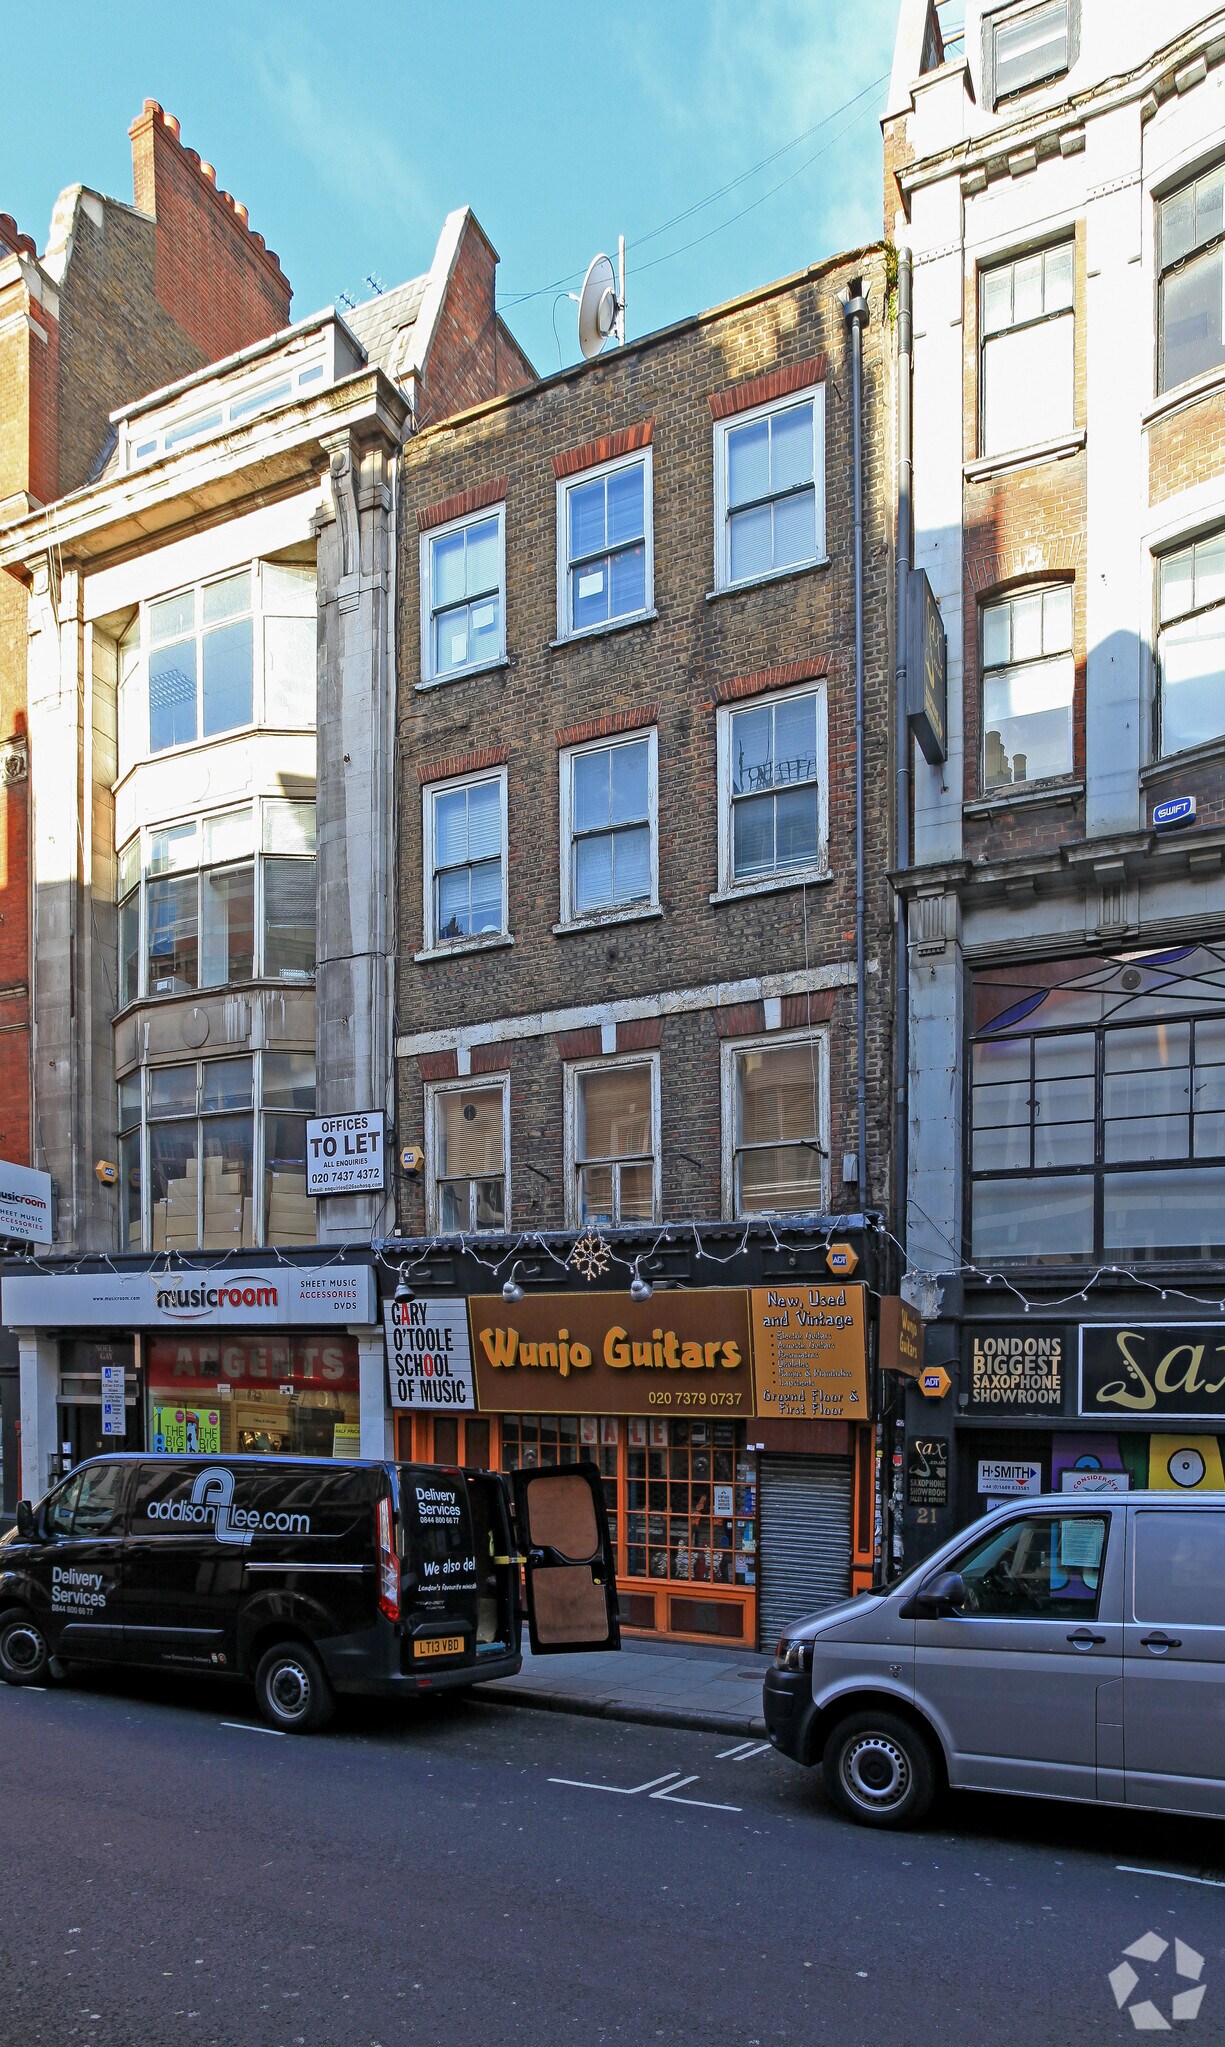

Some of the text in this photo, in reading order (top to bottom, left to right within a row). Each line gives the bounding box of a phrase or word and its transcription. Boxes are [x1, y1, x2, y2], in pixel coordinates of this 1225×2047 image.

[1158, 802, 1188, 818] SWIFT
[321, 1117, 368, 1133] OFFICES
[310, 1131, 380, 1158] TO LET
[336, 1158, 368, 1167] ENQUIRIES
[312, 1168, 379, 1184] 020 7437 4372
[0, 1190, 46, 1208] usicroom
[0, 1216, 43, 1231] CCESSORIES
[21, 1213, 42, 1223] MUSIC
[10, 1226, 29, 1234] DVDS
[832, 1256, 847, 1264] ADT
[300, 1279, 357, 1288] SHEET MUSIC
[156, 1281, 278, 1308] musicroom
[300, 1290, 357, 1298] ACCESSORIES
[767, 1289, 846, 1309] New, Used
[334, 1302, 357, 1310] DVDS
[391, 1303, 427, 1326] GARY
[763, 1310, 854, 1330] and Vintage
[393, 1328, 453, 1352] O'TOOLE
[973, 1338, 1061, 1356] LONDONS
[479, 1326, 742, 1377] Wunjo Guitars
[395, 1353, 453, 1377] SCHOOL
[973, 1356, 1061, 1375] BIGGEST
[925, 1378, 939, 1387] ADT
[973, 1375, 1061, 1390] SAXOPHONE
[398, 1379, 466, 1403] OF MUSIC
[649, 1391, 742, 1405] 020 7379 0737
[763, 1389, 859, 1402] Ground Floor &
[973, 1389, 1061, 1404] SHOWROOM
[779, 1403, 844, 1415] First Floor
[165, 1425, 183, 1436] THE
[198, 1427, 217, 1438] THE
[583, 1419, 664, 1443] SALE
[165, 1436, 183, 1447] BIG
[199, 1438, 217, 1449] BIG
[909, 1441, 947, 1477] Sax
[910, 1479, 946, 1488] SAXOPHONE
[1073, 1475, 1118, 1491] CONSIDERATE
[415, 1487, 455, 1504] Delivery
[910, 1487, 946, 1496] SHOWROOM
[418, 1502, 460, 1516] Services
[917, 1507, 937, 1524] 21
[420, 1516, 434, 1524] 0844
[435, 1516, 445, 1524] 800
[424, 1562, 439, 1577] We
[443, 1559, 460, 1573] also
[52, 1566, 103, 1590] Delivery
[418, 1584, 441, 1592] London's
[51, 1585, 106, 1607] Services
[51, 1604, 66, 1612] 0844
[67, 1605, 78, 1613] 800
[420, 1638, 459, 1654] LT13 VBD
